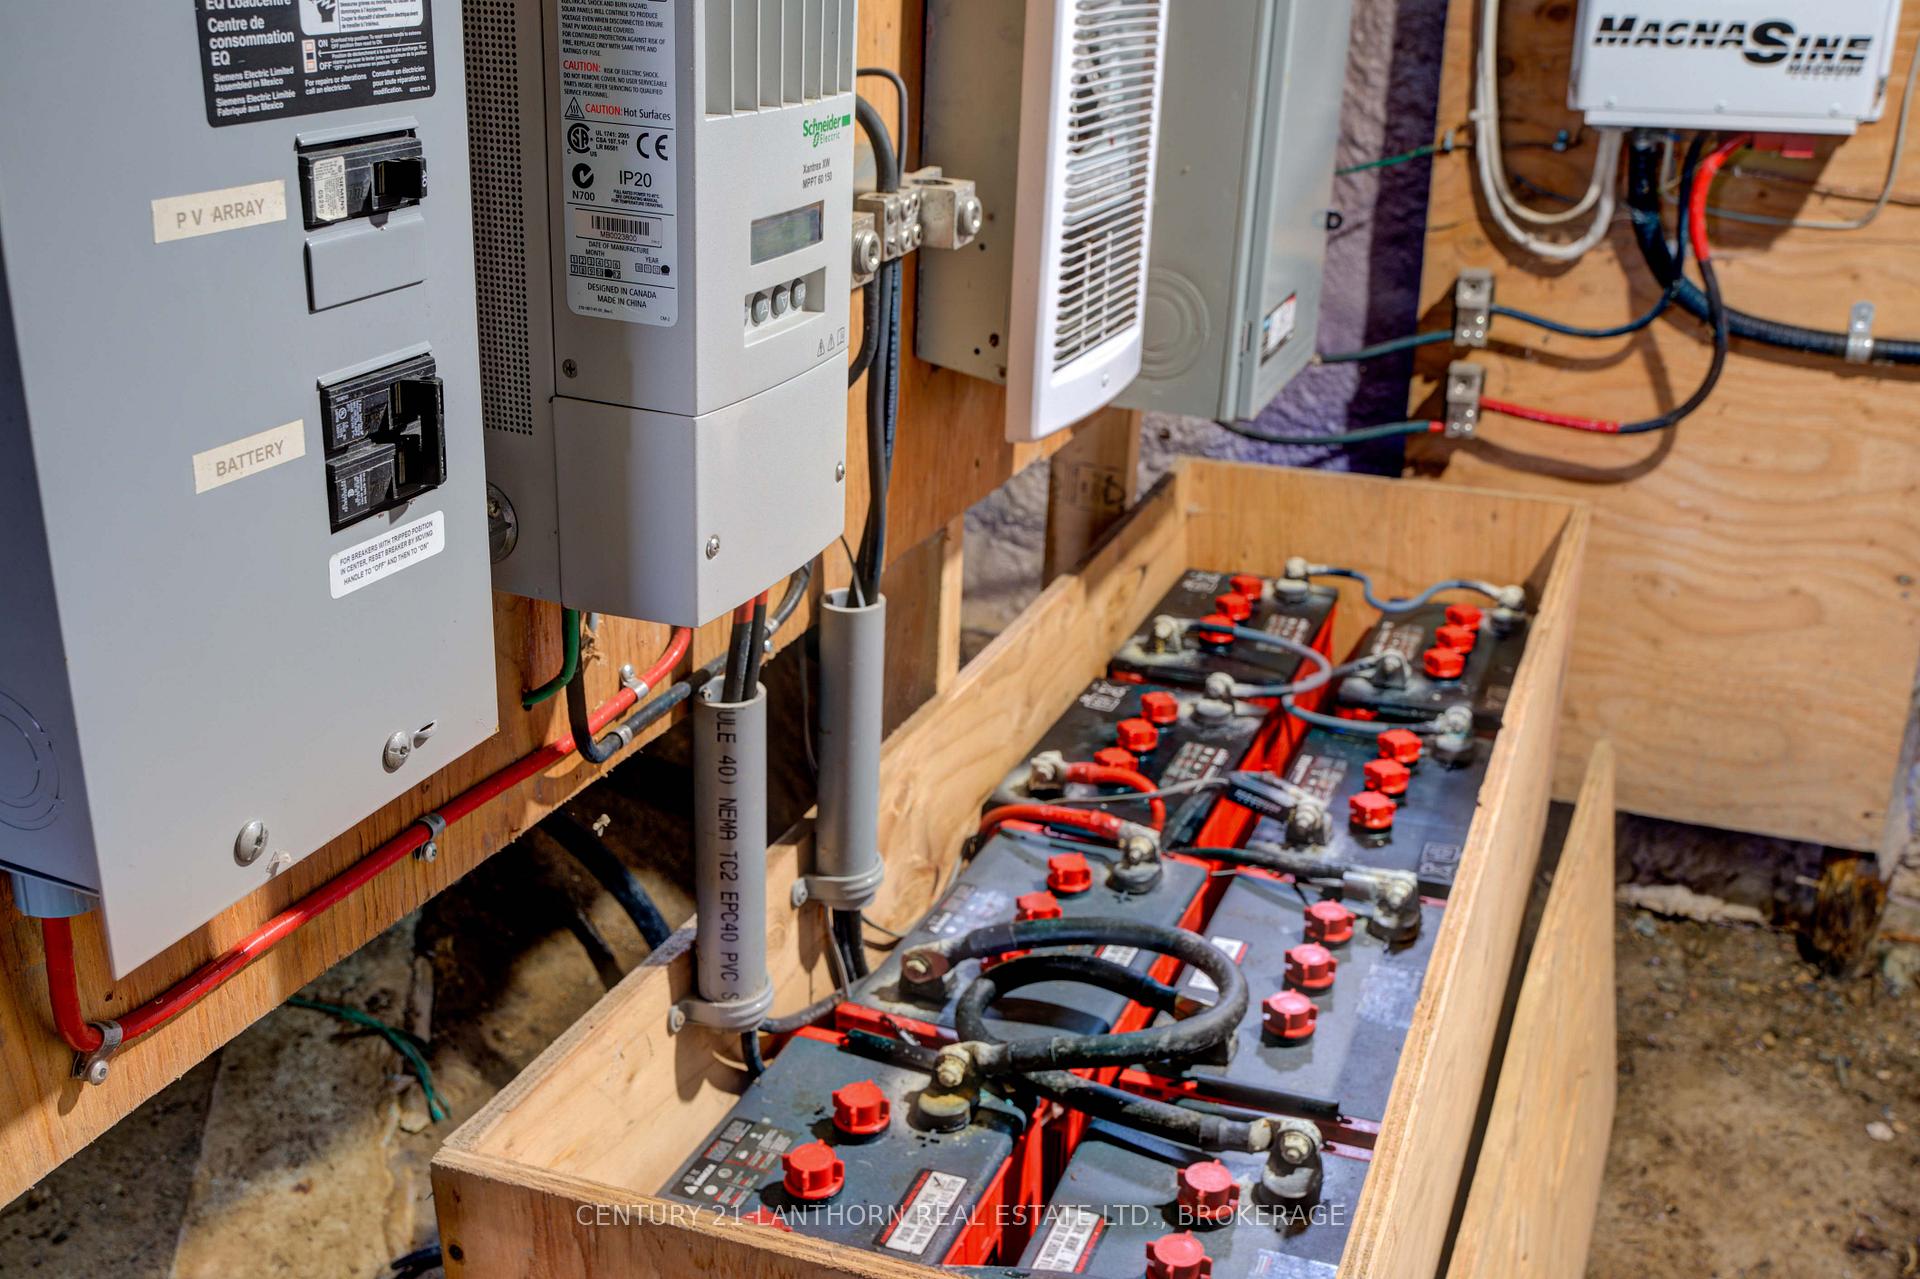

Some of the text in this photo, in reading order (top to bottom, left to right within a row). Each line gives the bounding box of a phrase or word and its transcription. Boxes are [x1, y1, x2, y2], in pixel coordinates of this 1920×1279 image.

[206, 0, 224, 10] EQ
[577, 6, 593, 14] PANELS
[636, 11, 658, 19] PRODUCE
[207, 15, 265, 33] Centre de
[209, 30, 294, 49] consommation
[318, 39, 328, 47] ON
[599, 33, 626, 41] PROTECTION
[1594, 17, 1872, 64] MAGNASINE
[211, 51, 230, 66] EQ
[563, 60, 601, 72] CAUTION:
[320, 62, 332, 71] OFF
[213, 66, 294, 83] Siemens Electric Limited
[305, 79, 314, 87] For
[315, 78, 333, 87] repairs
[341, 73, 367, 83] alterations
[215, 81, 252, 92] Assembled
[260, 77, 283, 86] Mexico
[305, 87, 315, 95] call
[324, 84, 352, 93] electrician.
[372, 80, 384, 88] pour
[385, 77, 396, 85] toute
[608, 84, 632, 92] SERVICING
[640, 87, 663, 95] QUALIFIED
[638, 79, 668, 87] SERVICEABLE
[215, 97, 245, 107] Siemens
[246, 93, 271, 103] Electric
[260, 101, 284, 110] Mexico
[585, 104, 671, 120] CAUTION: Hot Surfaces
[803, 114, 841, 136] Schneider
[820, 131, 840, 144] Electric
[637, 133, 668, 161] CE
[803, 158, 830, 174] Xantrex XW
[620, 170, 652, 188] IP20
[802, 176, 816, 189] MPPT
[818, 174, 824, 185] 60
[572, 190, 595, 201] N700
[213, 199, 265, 223] ARRAY
[610, 243, 649, 254] MANUFACTURE
[587, 283, 657, 299] DESIGNED IN CANADA
[597, 294, 616, 304] MADE
[626, 298, 646, 308] CHINA
[216, 439, 284, 477] BATTERY
[340, 520, 433, 566] FOR BREAKERS WITH TRIPPED POSITION
[369, 551, 384, 562] RESET
[385, 540, 407, 555] BREAKER
[415, 530, 433, 542] MOVING
[344, 570, 364, 585] HANDLE
[365, 567, 372, 576] TO
[387, 556, 397, 566] AND
[398, 550, 410, 561] THEN
[718, 755, 737, 785] 40)
[718, 798, 738, 840] NEMA
[719, 851, 738, 881] TC2
[720, 892, 739, 943] EPC40
[721, 952, 739, 981] PVC
